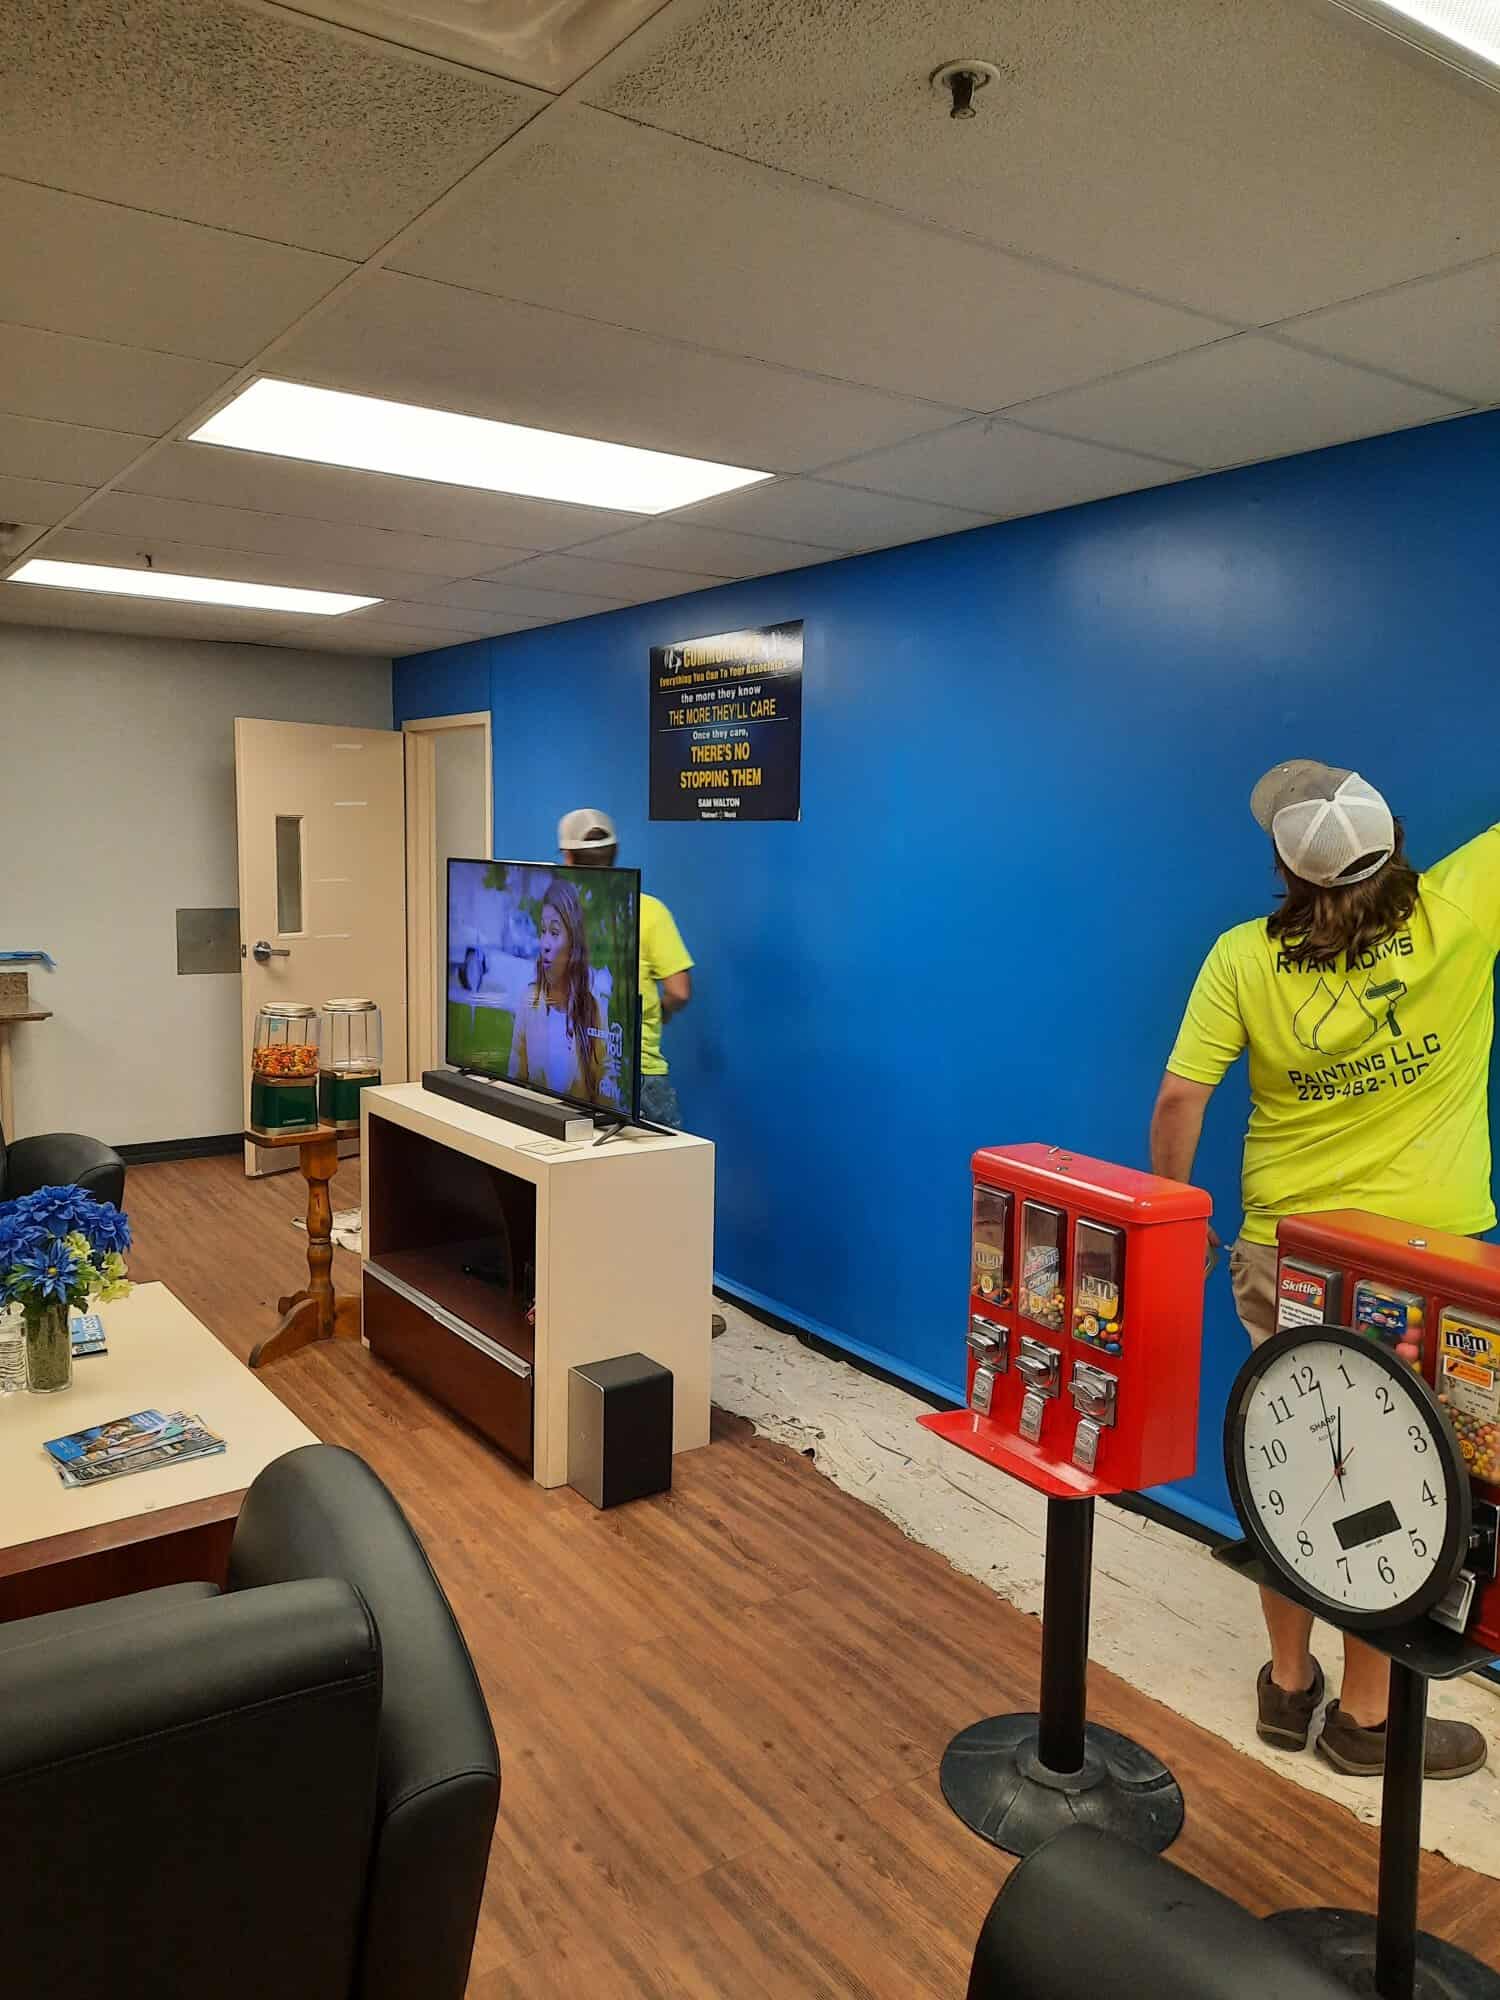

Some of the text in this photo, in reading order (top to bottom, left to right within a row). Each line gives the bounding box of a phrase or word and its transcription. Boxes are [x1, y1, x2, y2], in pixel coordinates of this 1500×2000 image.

[681, 685, 761, 704] the more they know
[669, 698, 776, 726] THE MORE THEY'LL CARE
[692, 730, 710, 741] Once
[712, 728, 728, 740] they
[691, 742, 750, 763] THERE'S NO
[680, 767, 761, 789] STOPPING THEM
[698, 797, 740, 808] SAM WALTON
[1288, 1033, 1441, 1086] PAINTING LLC
[1281, 1279, 1323, 1296] Skittles
[1289, 1366, 1320, 1400] 12
[1337, 1364, 1356, 1390] 1
[1267, 1396, 1295, 1425] 11
[1375, 1386, 1395, 1414] 2
[1407, 1425, 1428, 1454] 3
[1260, 1438, 1288, 1470] 10
[1268, 1489, 1286, 1516] 9
[1421, 1479, 1439, 1508] 4
[1296, 1530, 1314, 1557] 8
[1408, 1528, 1427, 1558] 5
[1336, 1556, 1352, 1585] 7
[1377, 1555, 1395, 1585] 6
